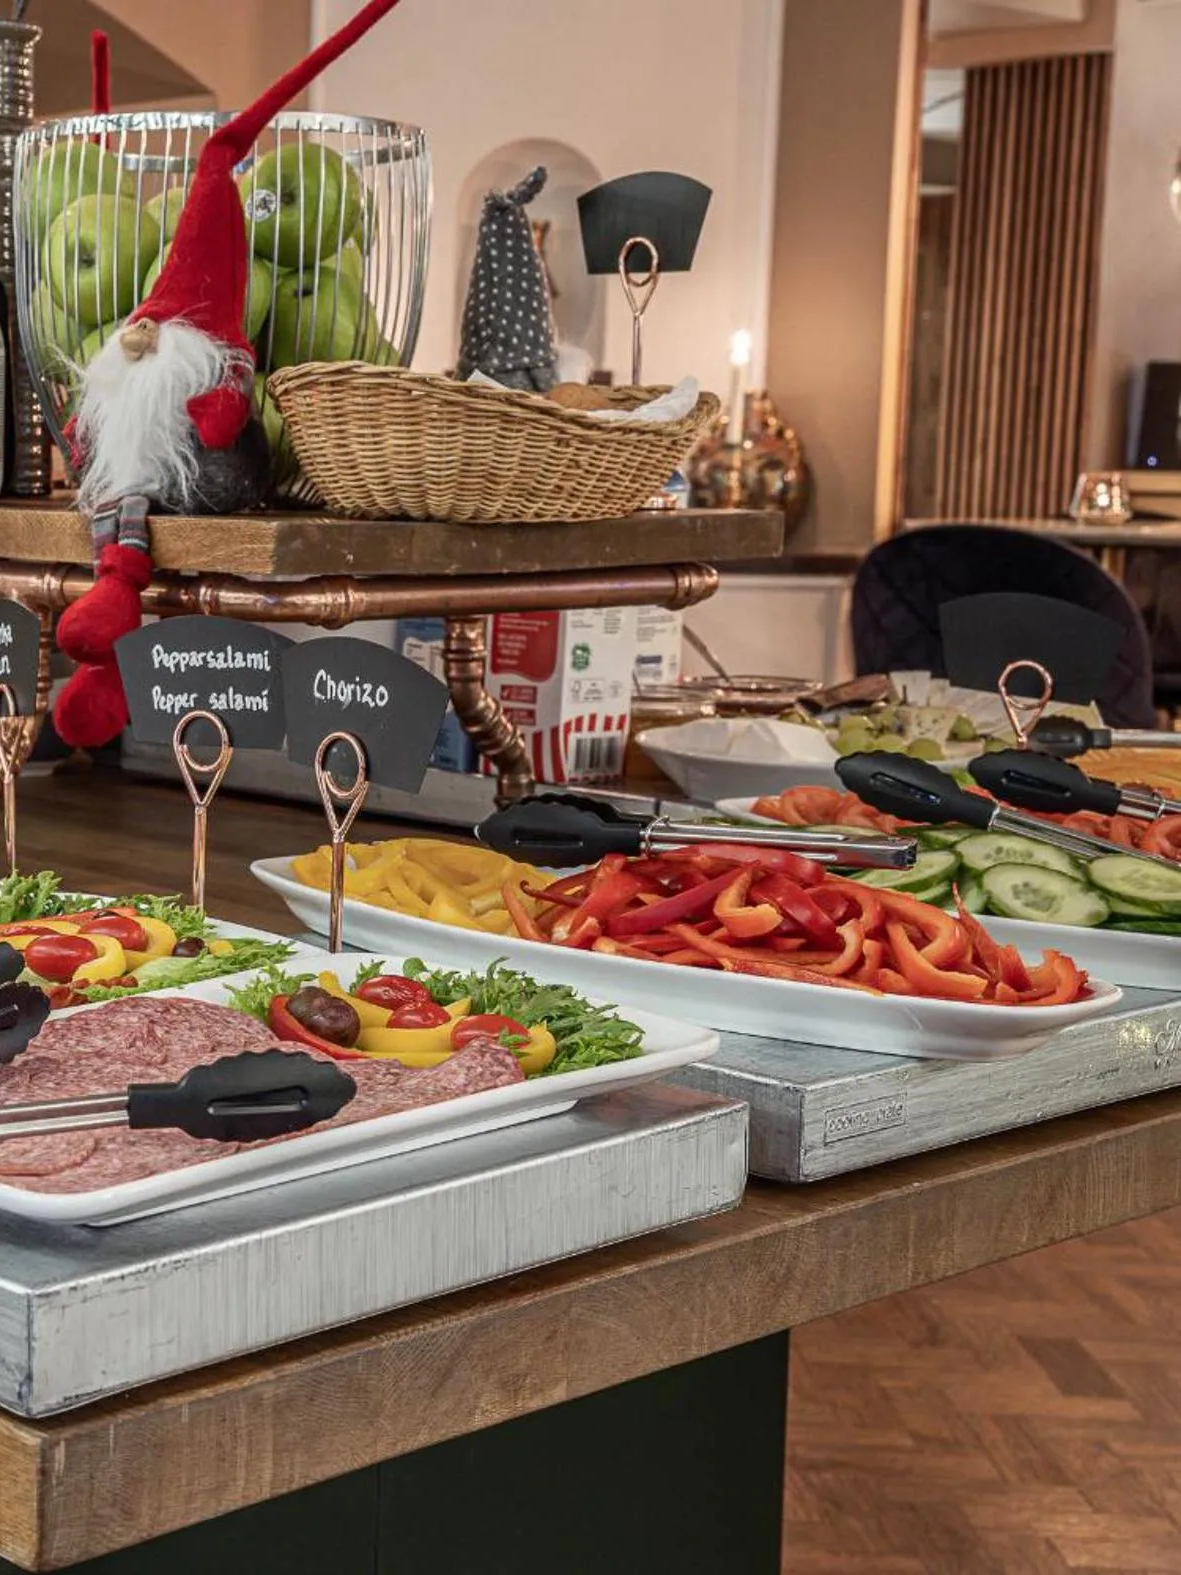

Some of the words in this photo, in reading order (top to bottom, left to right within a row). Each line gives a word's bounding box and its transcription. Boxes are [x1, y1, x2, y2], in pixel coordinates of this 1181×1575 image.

[151, 643, 271, 673] Pepparsalami
[151, 684, 199, 714] Pepper
[209, 686, 269, 712] salami
[313, 668, 389, 709] Chorizo
